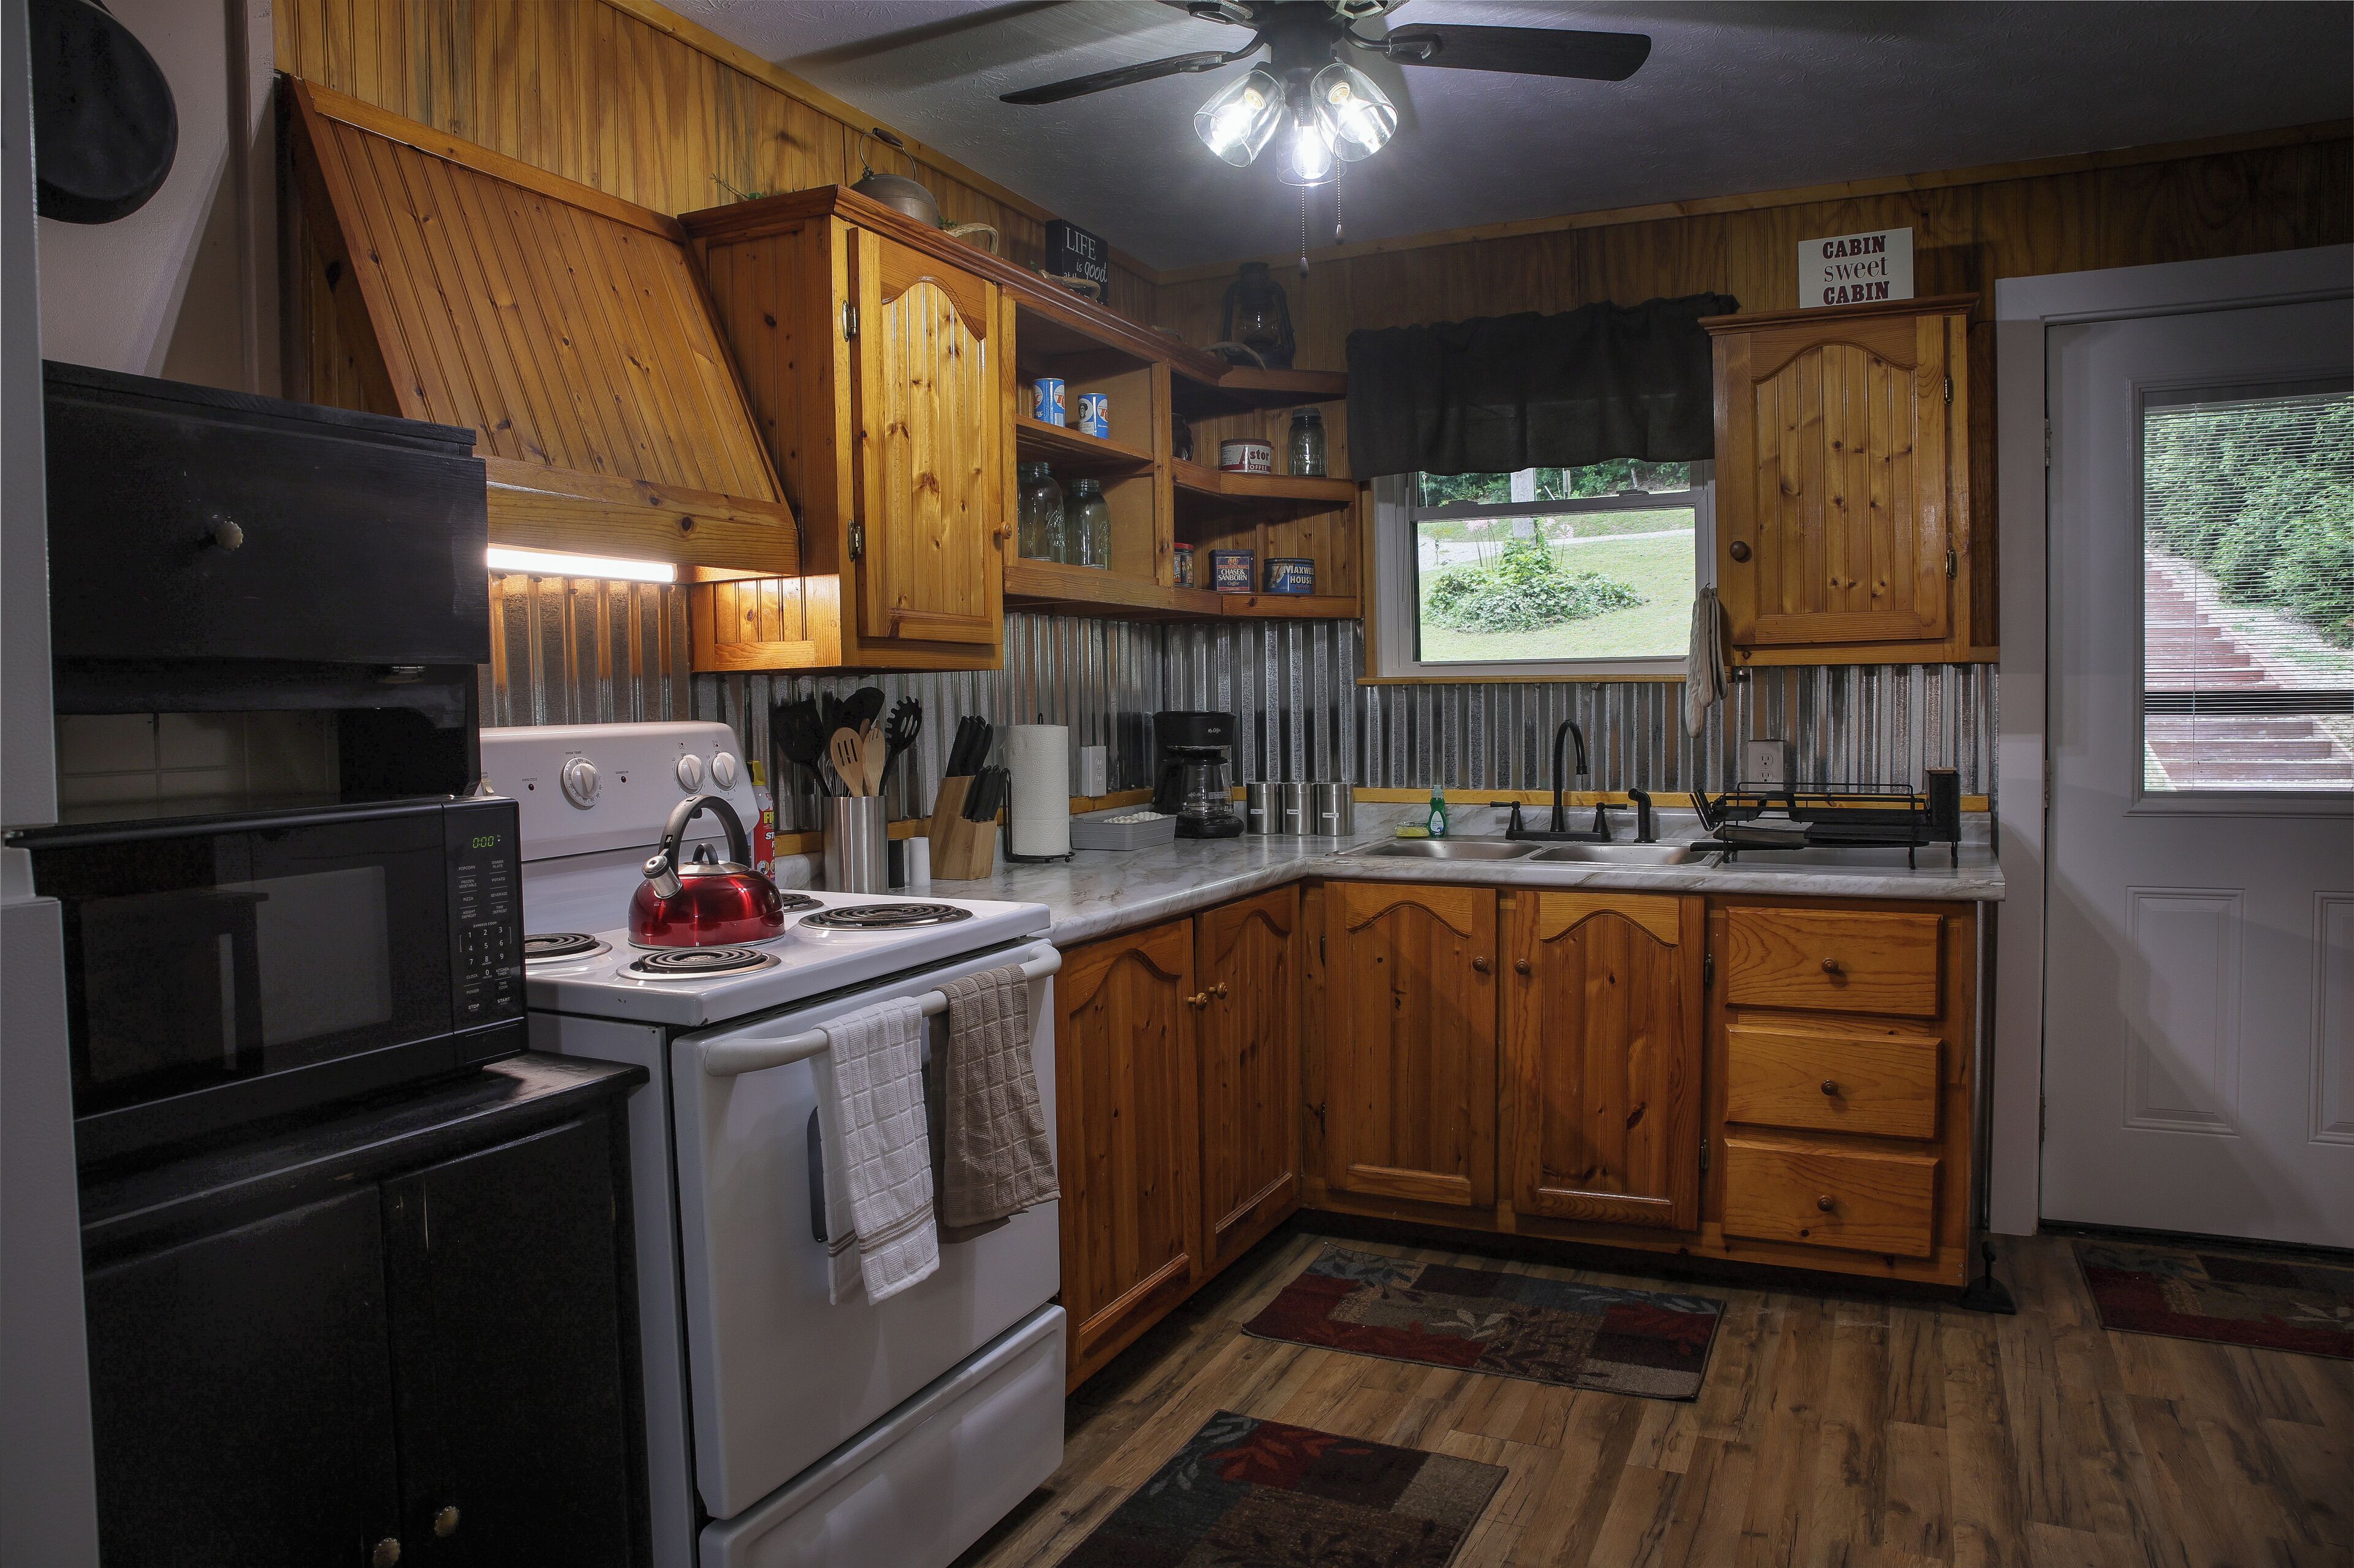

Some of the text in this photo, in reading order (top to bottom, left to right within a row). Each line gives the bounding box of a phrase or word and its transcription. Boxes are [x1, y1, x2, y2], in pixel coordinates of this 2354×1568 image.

[1065, 226, 1096, 261] LIFE
[1822, 235, 1886, 259] CABIN
[1076, 259, 1108, 283] is good
[1824, 256, 1889, 283] sweet
[1823, 281, 1890, 305] CABIN
[1238, 445, 1270, 465] Astor
